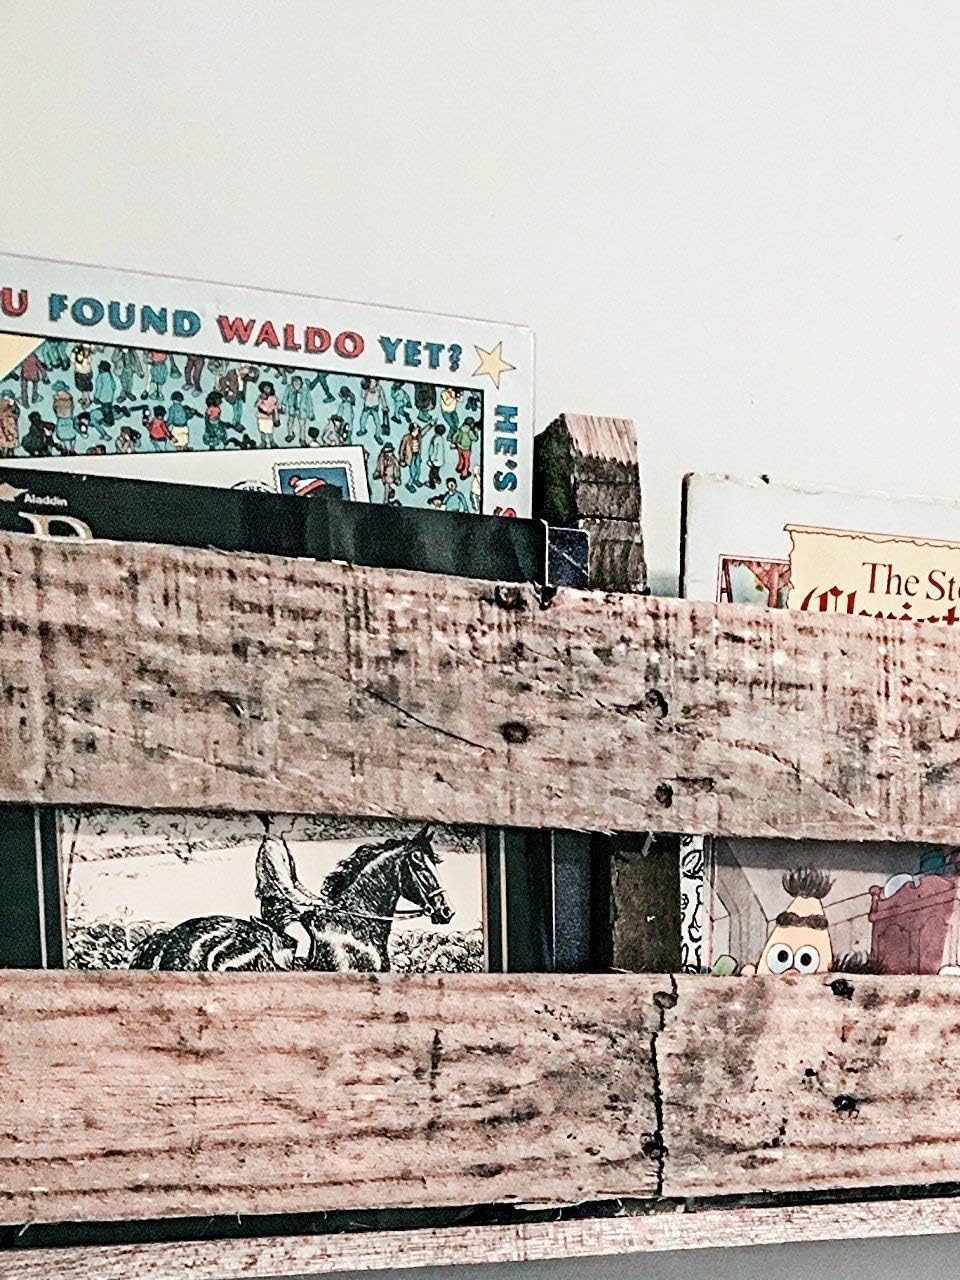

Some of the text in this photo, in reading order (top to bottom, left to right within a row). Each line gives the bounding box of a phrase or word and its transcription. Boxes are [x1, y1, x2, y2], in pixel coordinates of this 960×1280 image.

[48, 293, 201, 338] FOUND
[217, 315, 364, 359] WALDO
[377, 336, 463, 372] YET?
[494, 405, 518, 492] HE'S
[24, 493, 68, 506] Aladdin
[862, 561, 919, 596] The
